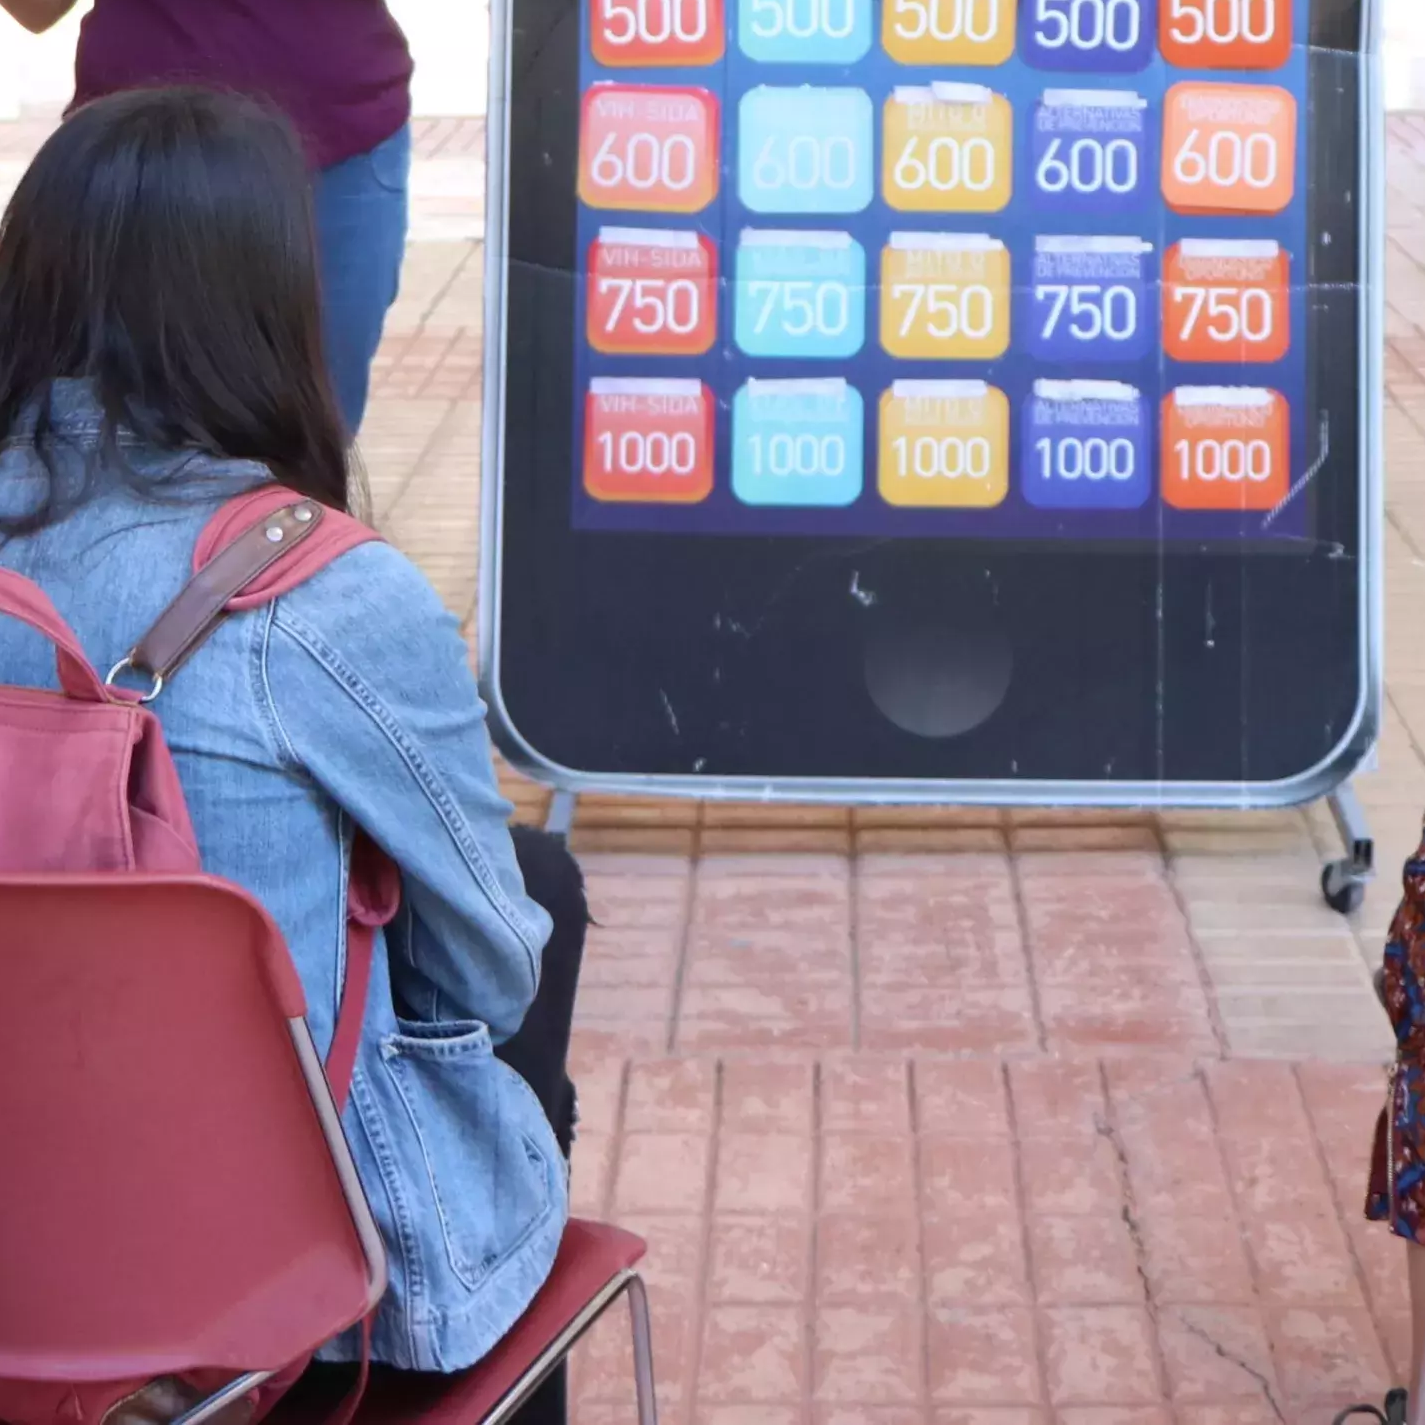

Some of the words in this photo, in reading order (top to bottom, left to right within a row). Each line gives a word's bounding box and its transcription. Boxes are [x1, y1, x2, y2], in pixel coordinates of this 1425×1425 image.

[591, 132, 696, 189] 600
[753, 135, 855, 190] 600
[894, 136, 994, 190] 600
[1037, 139, 1136, 193] 600
[1173, 129, 1277, 188] 600
[601, 248, 703, 268] VIH-SIDA
[598, 278, 698, 334] 750
[748, 280, 849, 337] 750
[891, 284, 993, 338] 750
[1035, 285, 1136, 341] 750
[1173, 286, 1273, 342] 750
[599, 393, 698, 415] VIH-SIDA
[597, 431, 695, 475] 1000
[748, 433, 845, 477] 1000
[892, 436, 990, 478] 1000
[1035, 437, 1135, 480] 1000
[1174, 438, 1271, 482] 1000
